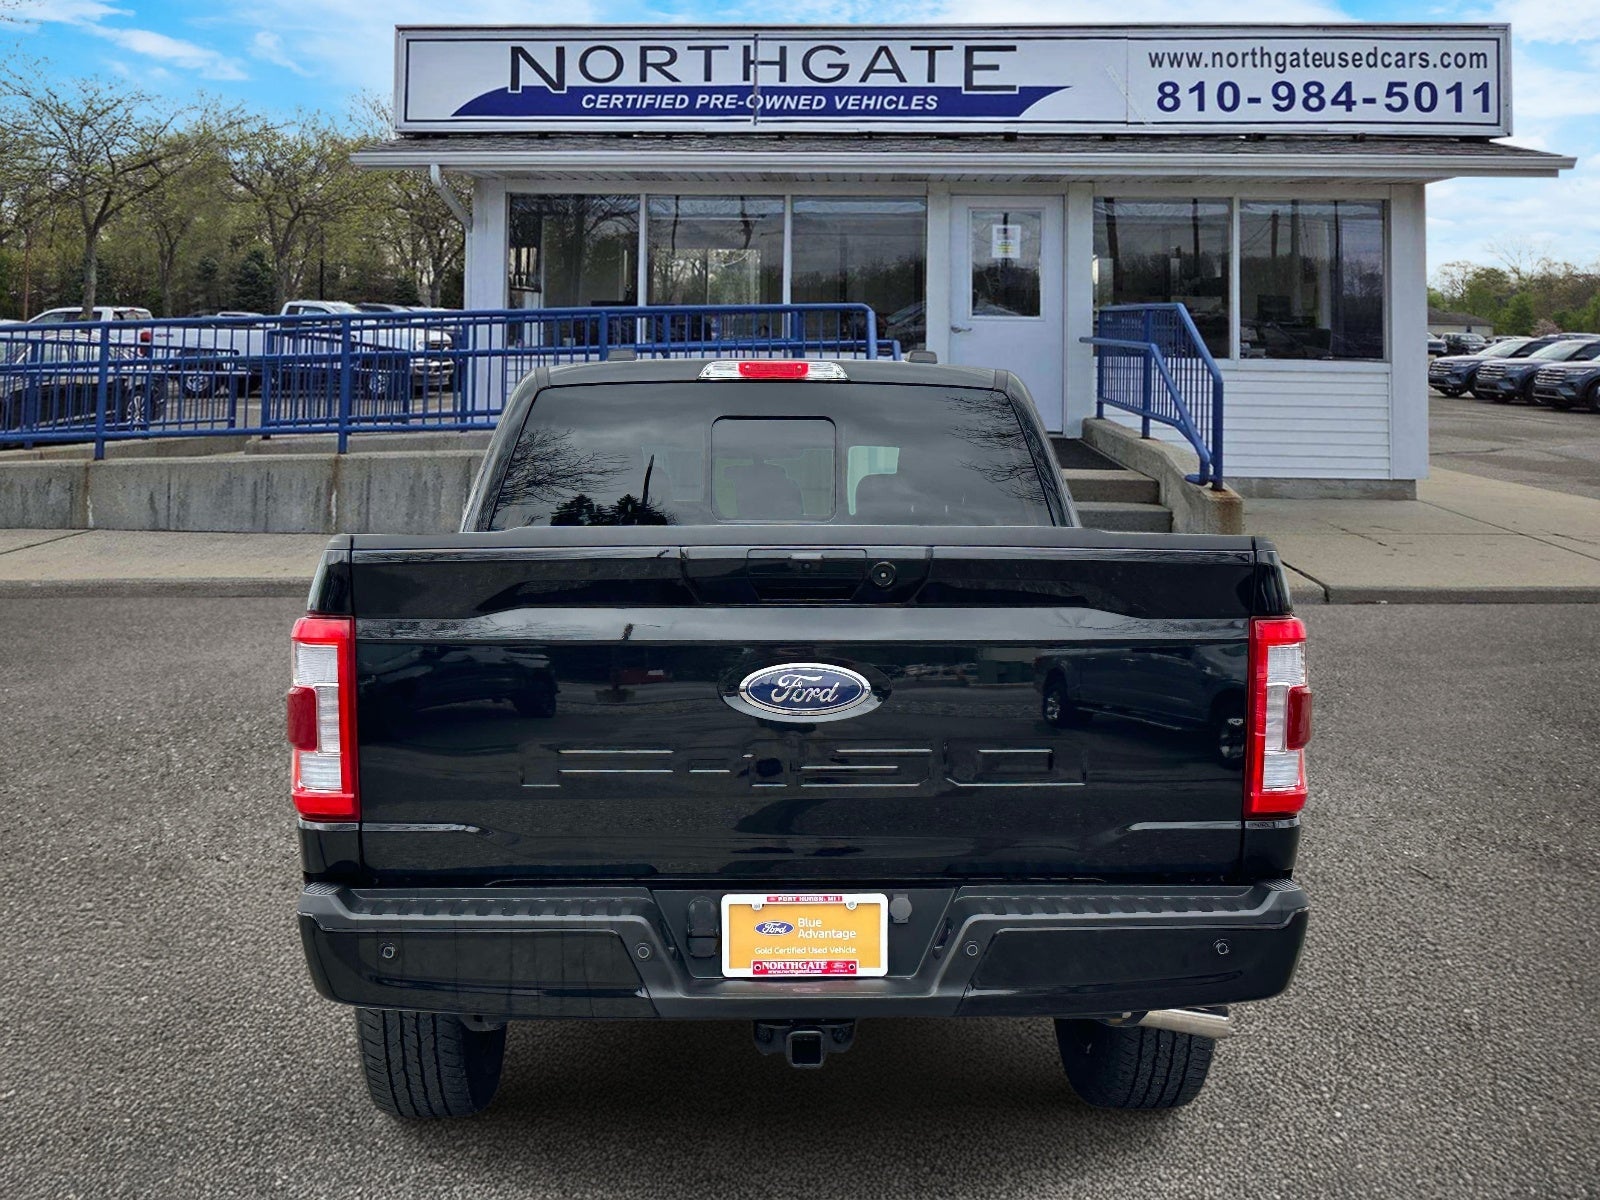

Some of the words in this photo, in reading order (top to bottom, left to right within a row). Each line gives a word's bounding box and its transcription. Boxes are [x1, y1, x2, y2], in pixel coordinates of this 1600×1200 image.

[510, 44, 1017, 93] NORTHGATE
[1148, 46, 1489, 74] www.northgateusedcars.com
[581, 93, 690, 110] CERTIFIED
[695, 93, 827, 111] PRE-OWNED
[834, 94, 938, 111] VEHICLES
[1156, 79, 1492, 114] 810-984-5011
[770, 673, 840, 703] Ford
[797, 917, 823, 928] Blue
[797, 928, 857, 941] Advantage
[754, 947, 773, 955] Gold
[774, 946, 806, 955] Certified
[808, 946, 828, 955] Used
[829, 946, 857, 955] Vehicle
[762, 961, 828, 970] NORTHGATE
